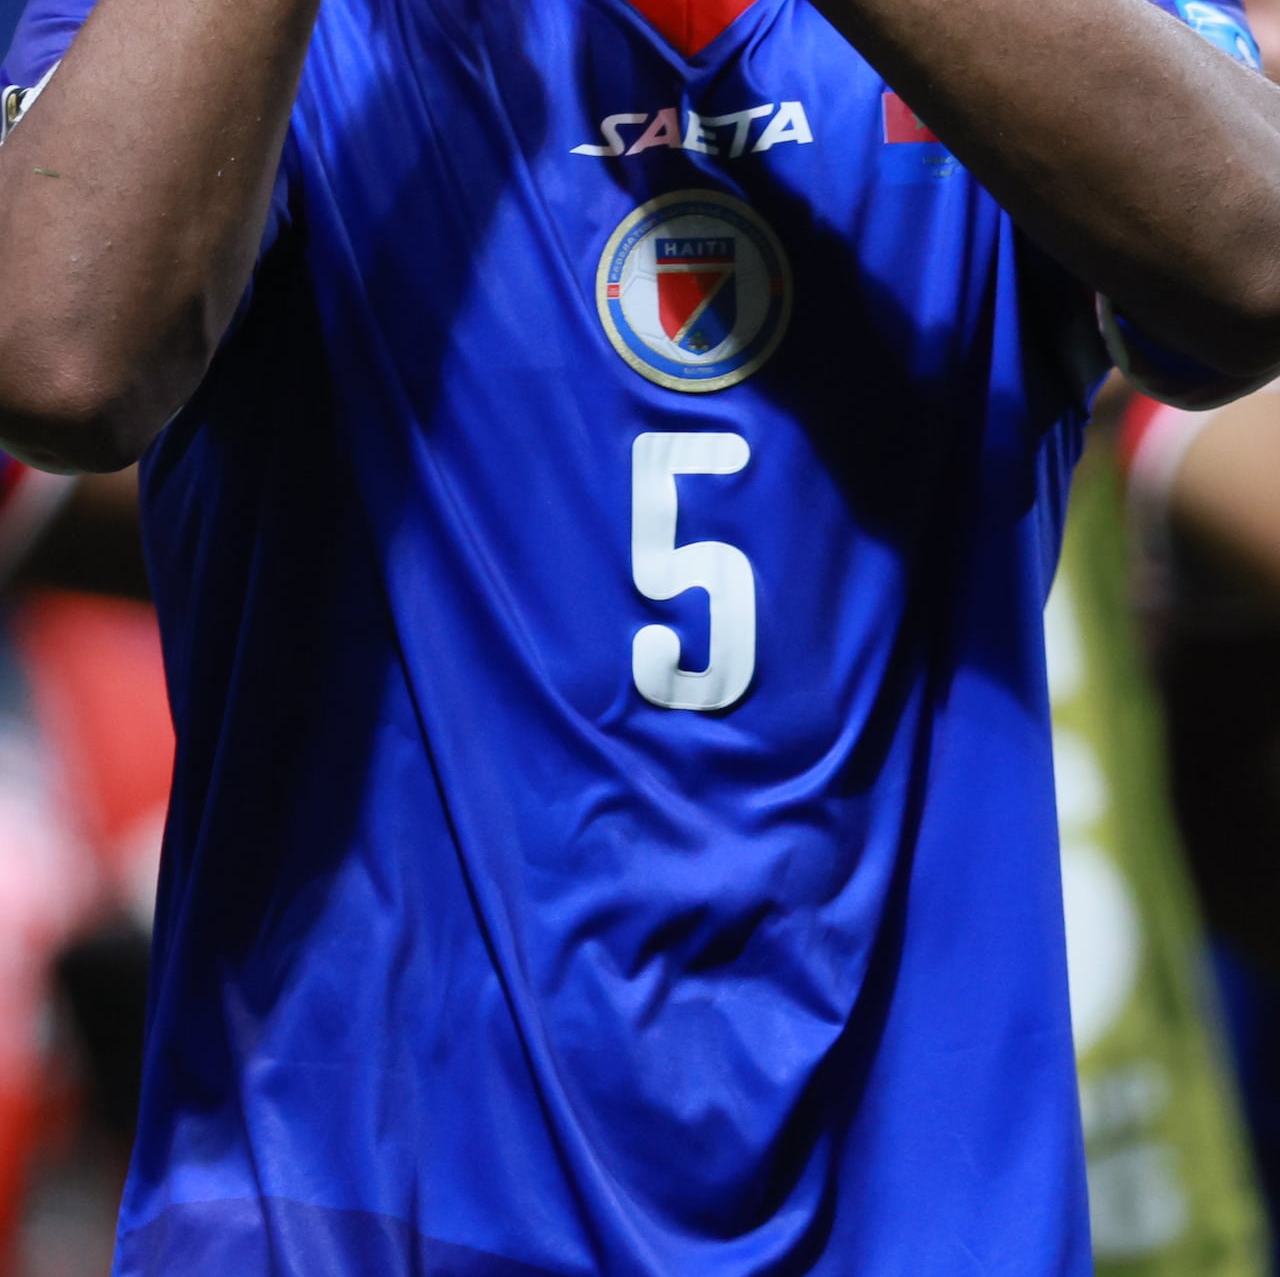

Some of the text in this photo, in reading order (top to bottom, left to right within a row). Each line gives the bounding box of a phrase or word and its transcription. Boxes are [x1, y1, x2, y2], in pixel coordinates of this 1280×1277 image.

[570, 101, 813, 157] SAETA
[663, 241, 727, 259] HAITI
[631, 431, 756, 710] 5
